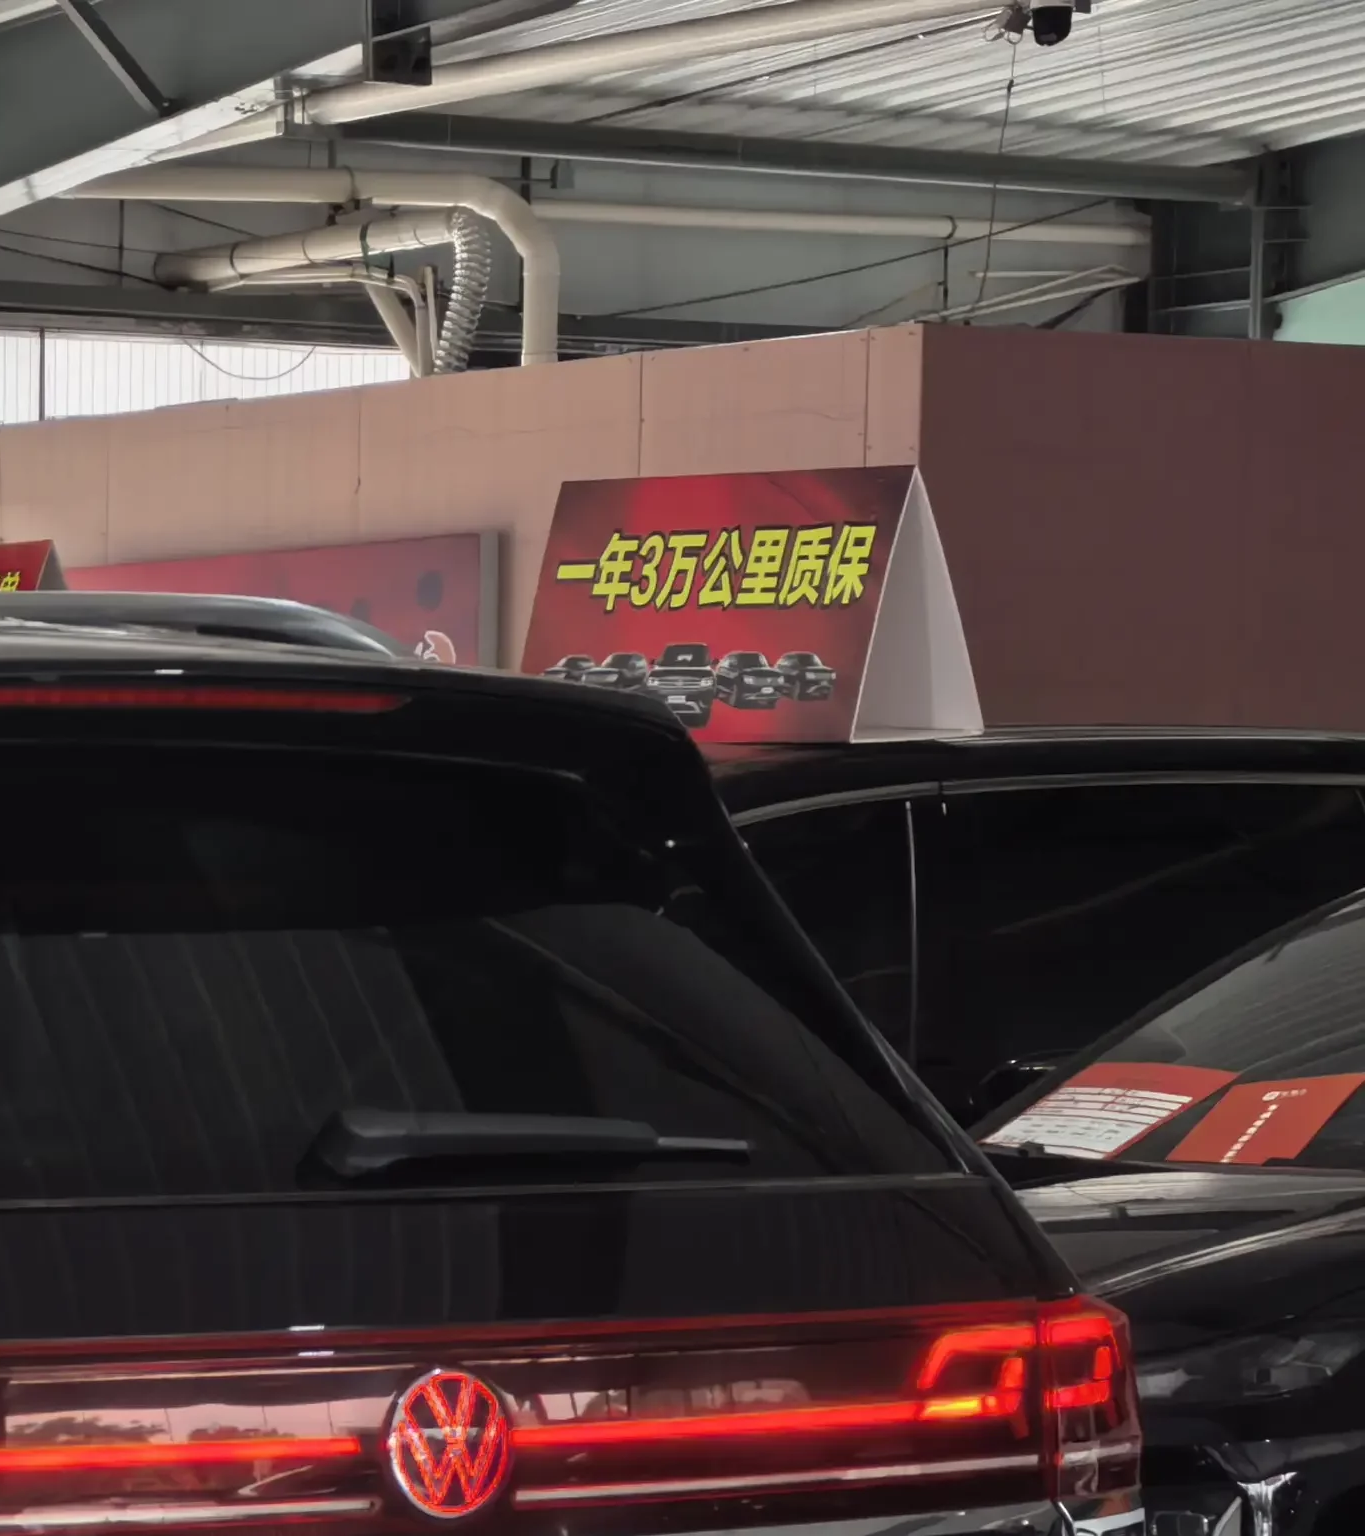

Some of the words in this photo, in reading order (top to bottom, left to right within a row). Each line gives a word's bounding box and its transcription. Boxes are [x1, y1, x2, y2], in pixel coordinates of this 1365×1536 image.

[556, 523, 878, 613] 一年3万公里质保
